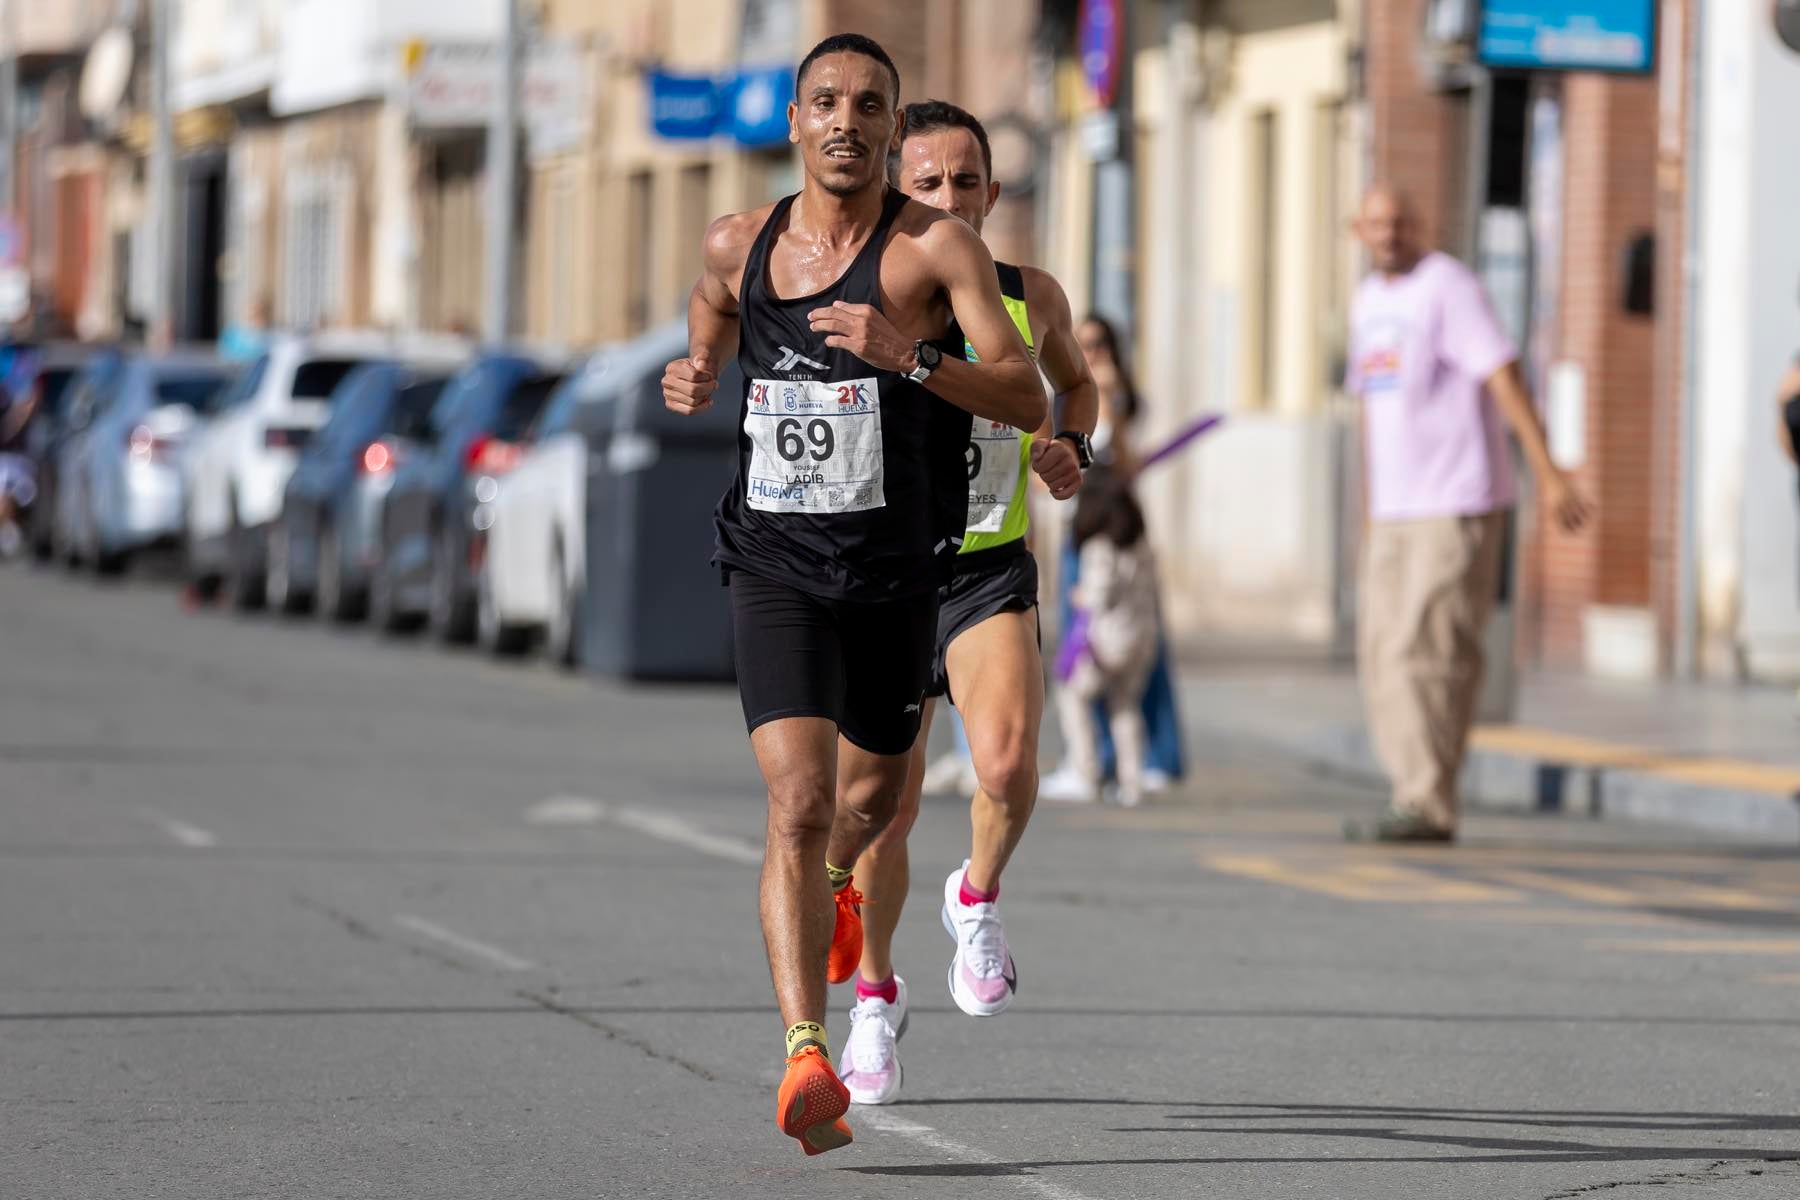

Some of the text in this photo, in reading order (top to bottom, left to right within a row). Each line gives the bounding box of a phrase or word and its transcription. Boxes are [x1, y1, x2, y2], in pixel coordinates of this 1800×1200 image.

[837, 383, 869, 405] 21K
[838, 404, 868, 413] HUELVA
[776, 418, 835, 461] 69
[752, 479, 803, 500] Huelva
[968, 494, 997, 504] EYES
